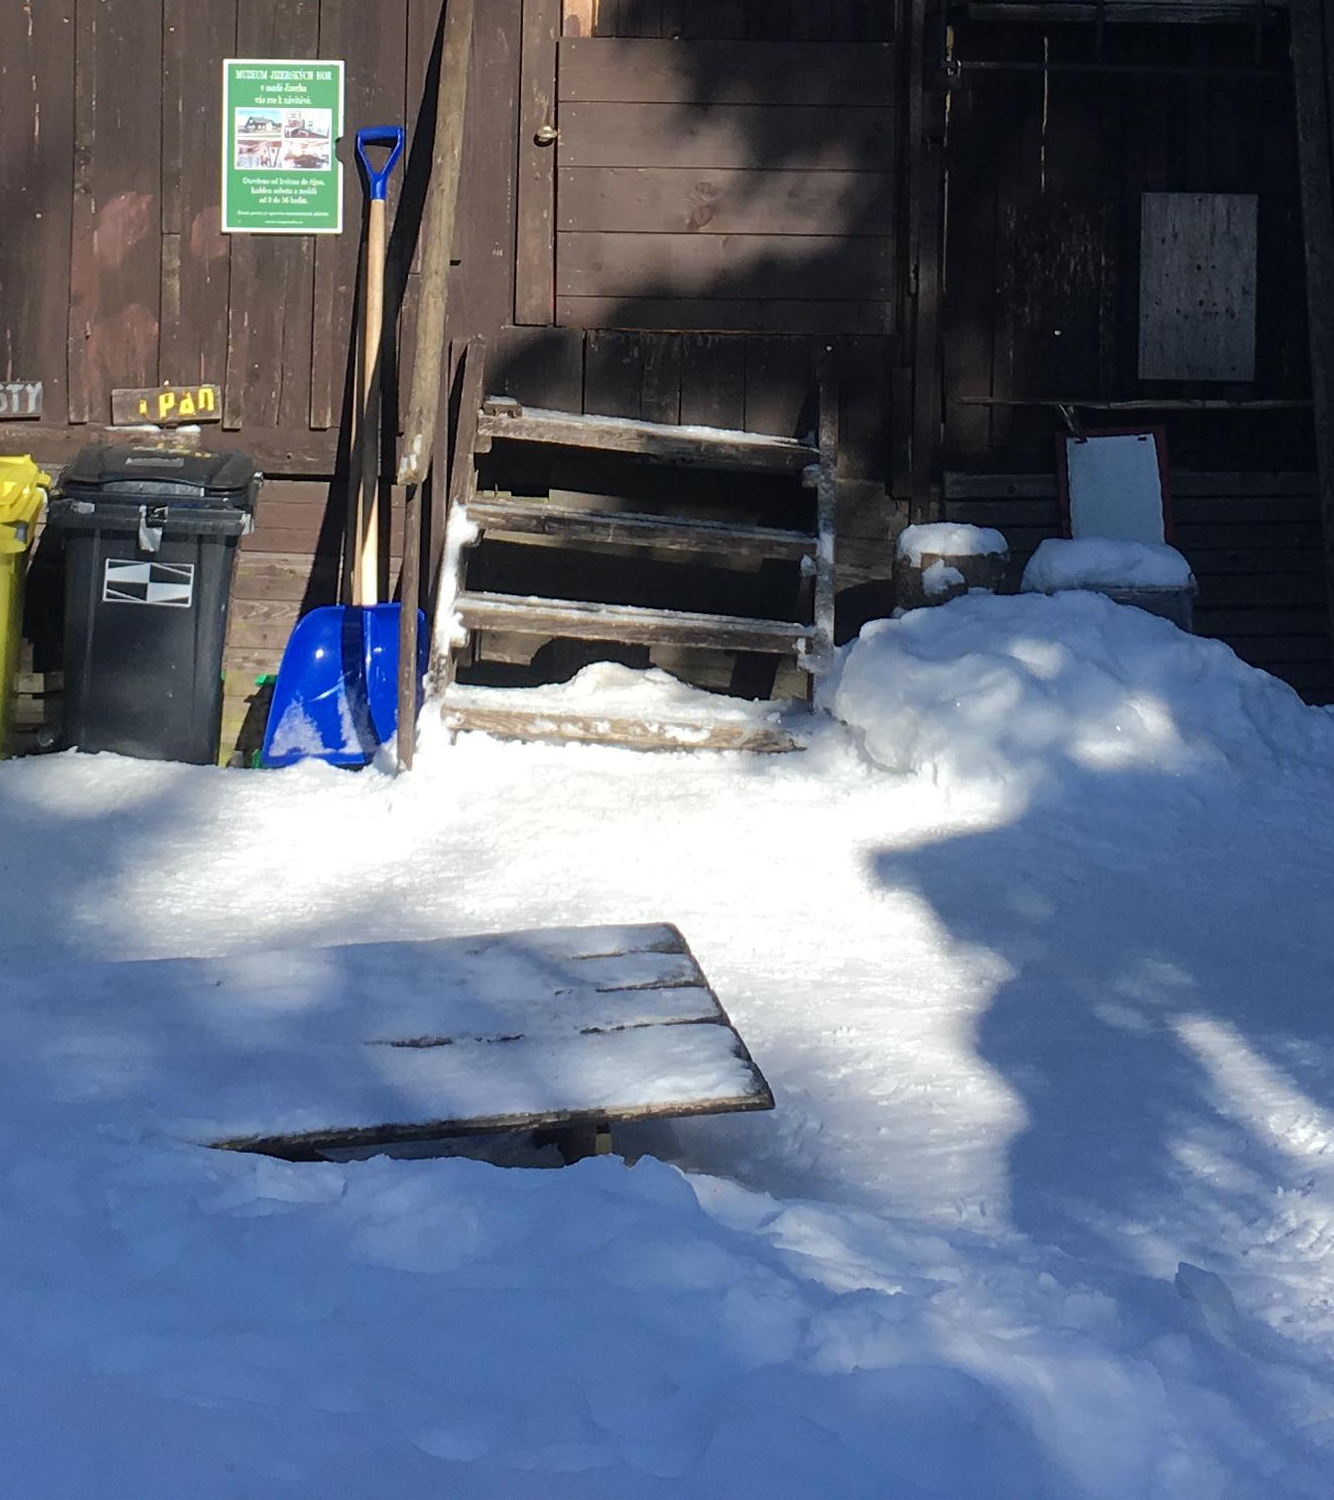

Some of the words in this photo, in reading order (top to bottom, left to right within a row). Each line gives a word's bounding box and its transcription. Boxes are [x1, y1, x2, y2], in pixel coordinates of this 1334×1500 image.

[235, 70, 267, 80] MUZEUM
[269, 68, 313, 80] JIZERSKÝCH
[316, 70, 332, 80] HOR
